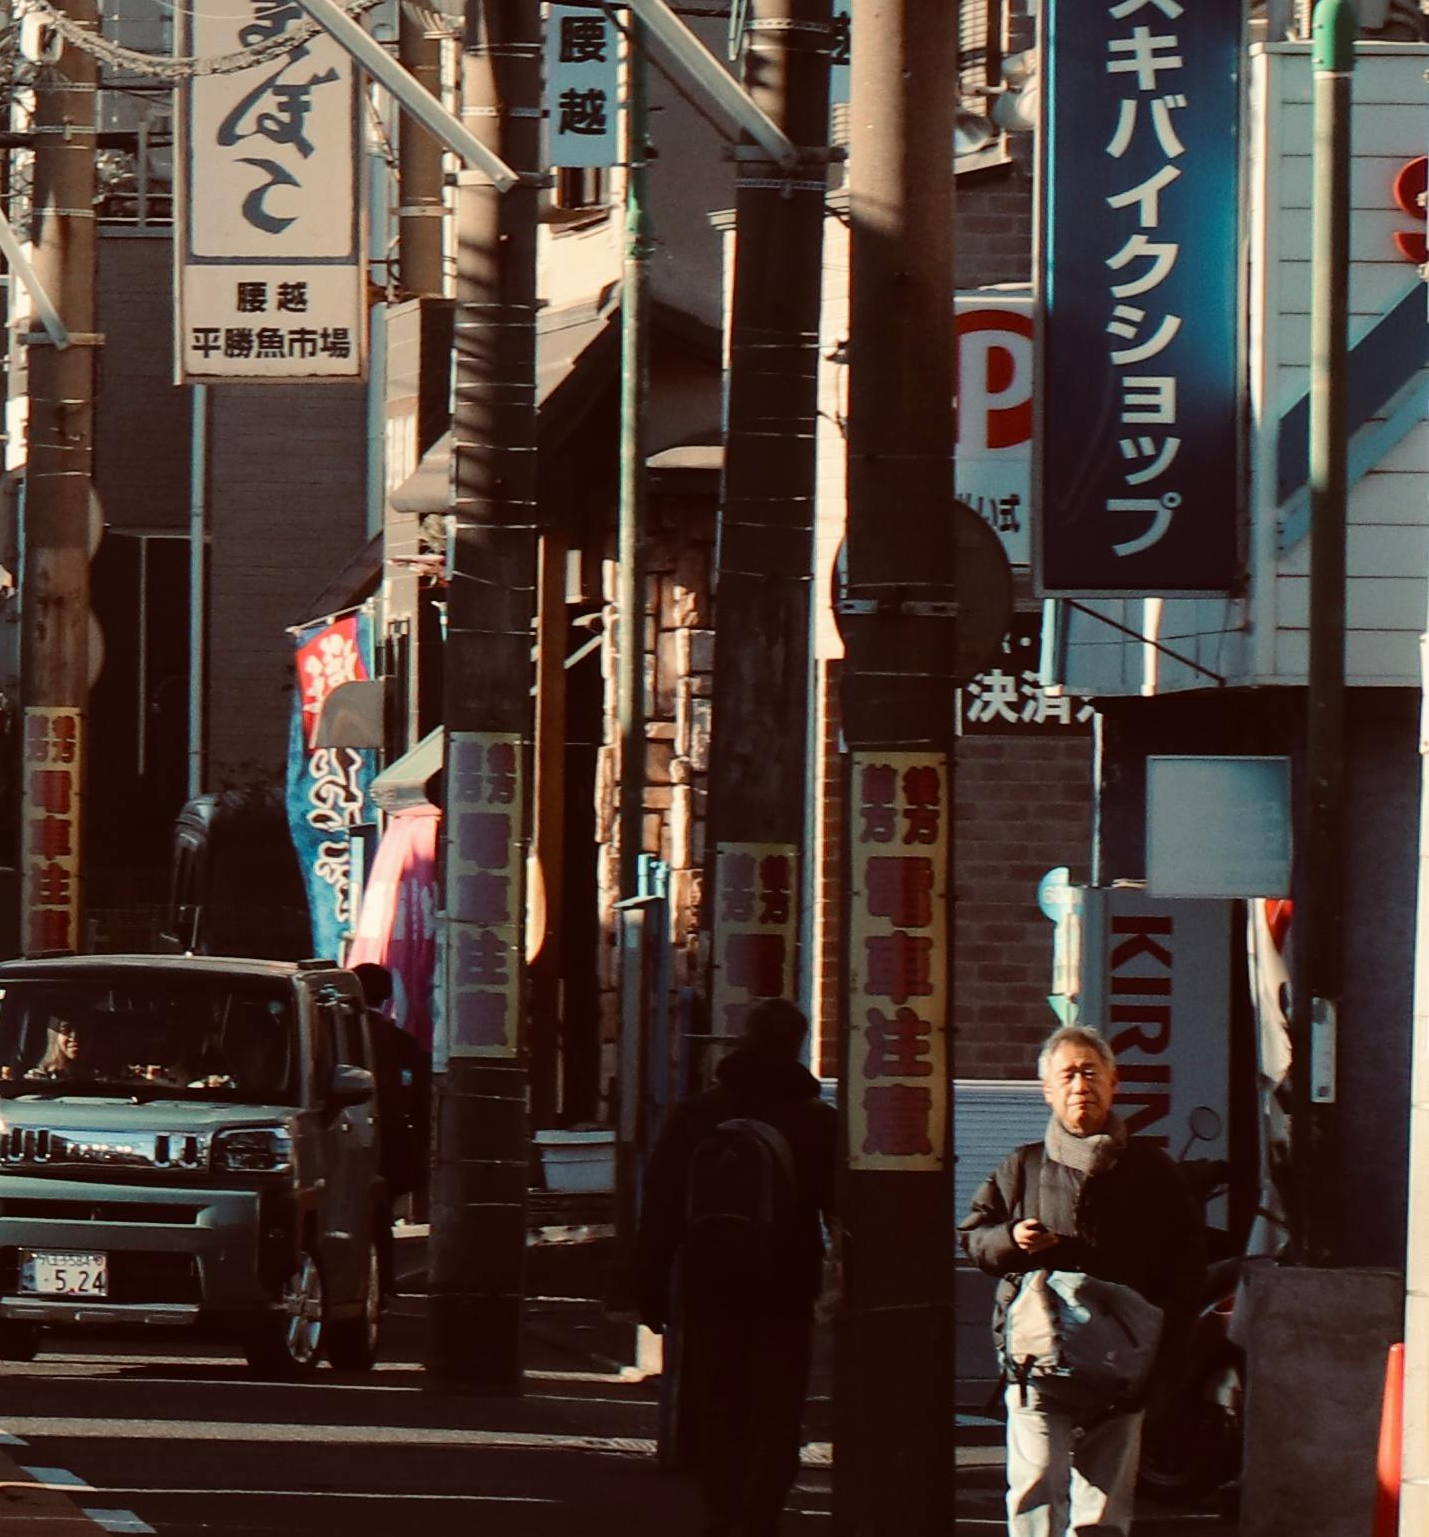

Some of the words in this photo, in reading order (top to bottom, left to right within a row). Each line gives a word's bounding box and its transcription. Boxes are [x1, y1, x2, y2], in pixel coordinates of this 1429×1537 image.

[559, 15, 607, 135] 腰越
[236, 281, 308, 313] 腰越
[192, 327, 351, 359] 平勝魚市場
[966, 668, 1095, 725] 決済
[862, 856, 935, 1156] 電車注意
[1110, 915, 1173, 1153] KIRIN
